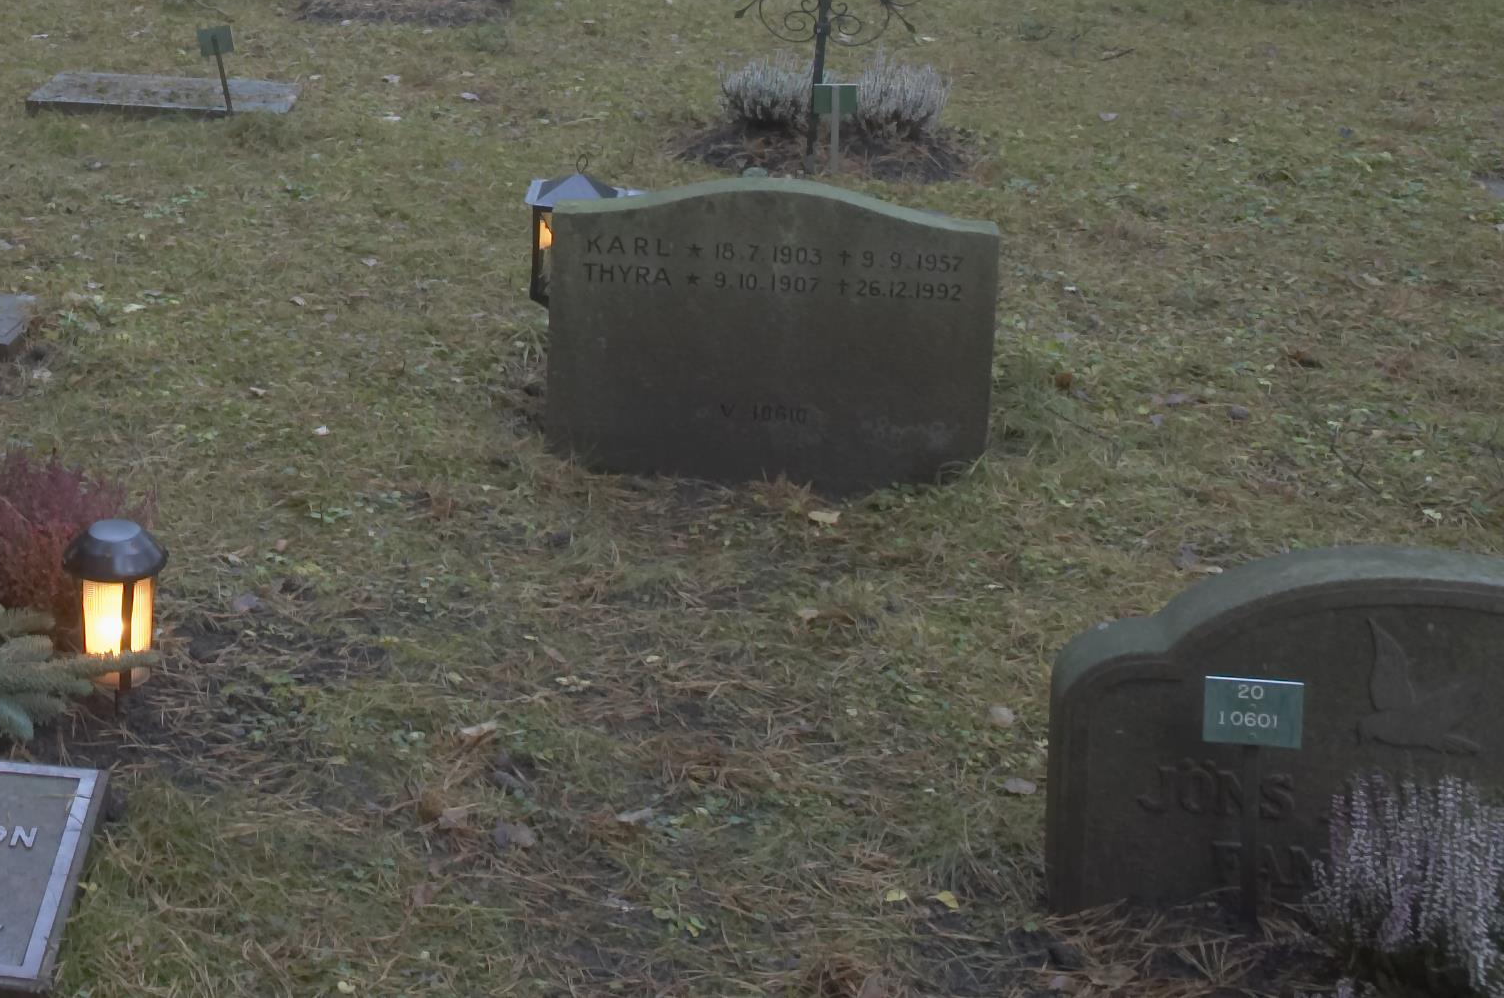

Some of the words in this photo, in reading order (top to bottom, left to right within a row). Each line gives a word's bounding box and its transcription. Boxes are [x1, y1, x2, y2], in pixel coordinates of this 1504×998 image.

[586, 235, 671, 257] KARL
[582, 262, 672, 287] THYRA
[1237, 683, 1265, 700] 20
[1218, 710, 1279, 729] 10601
